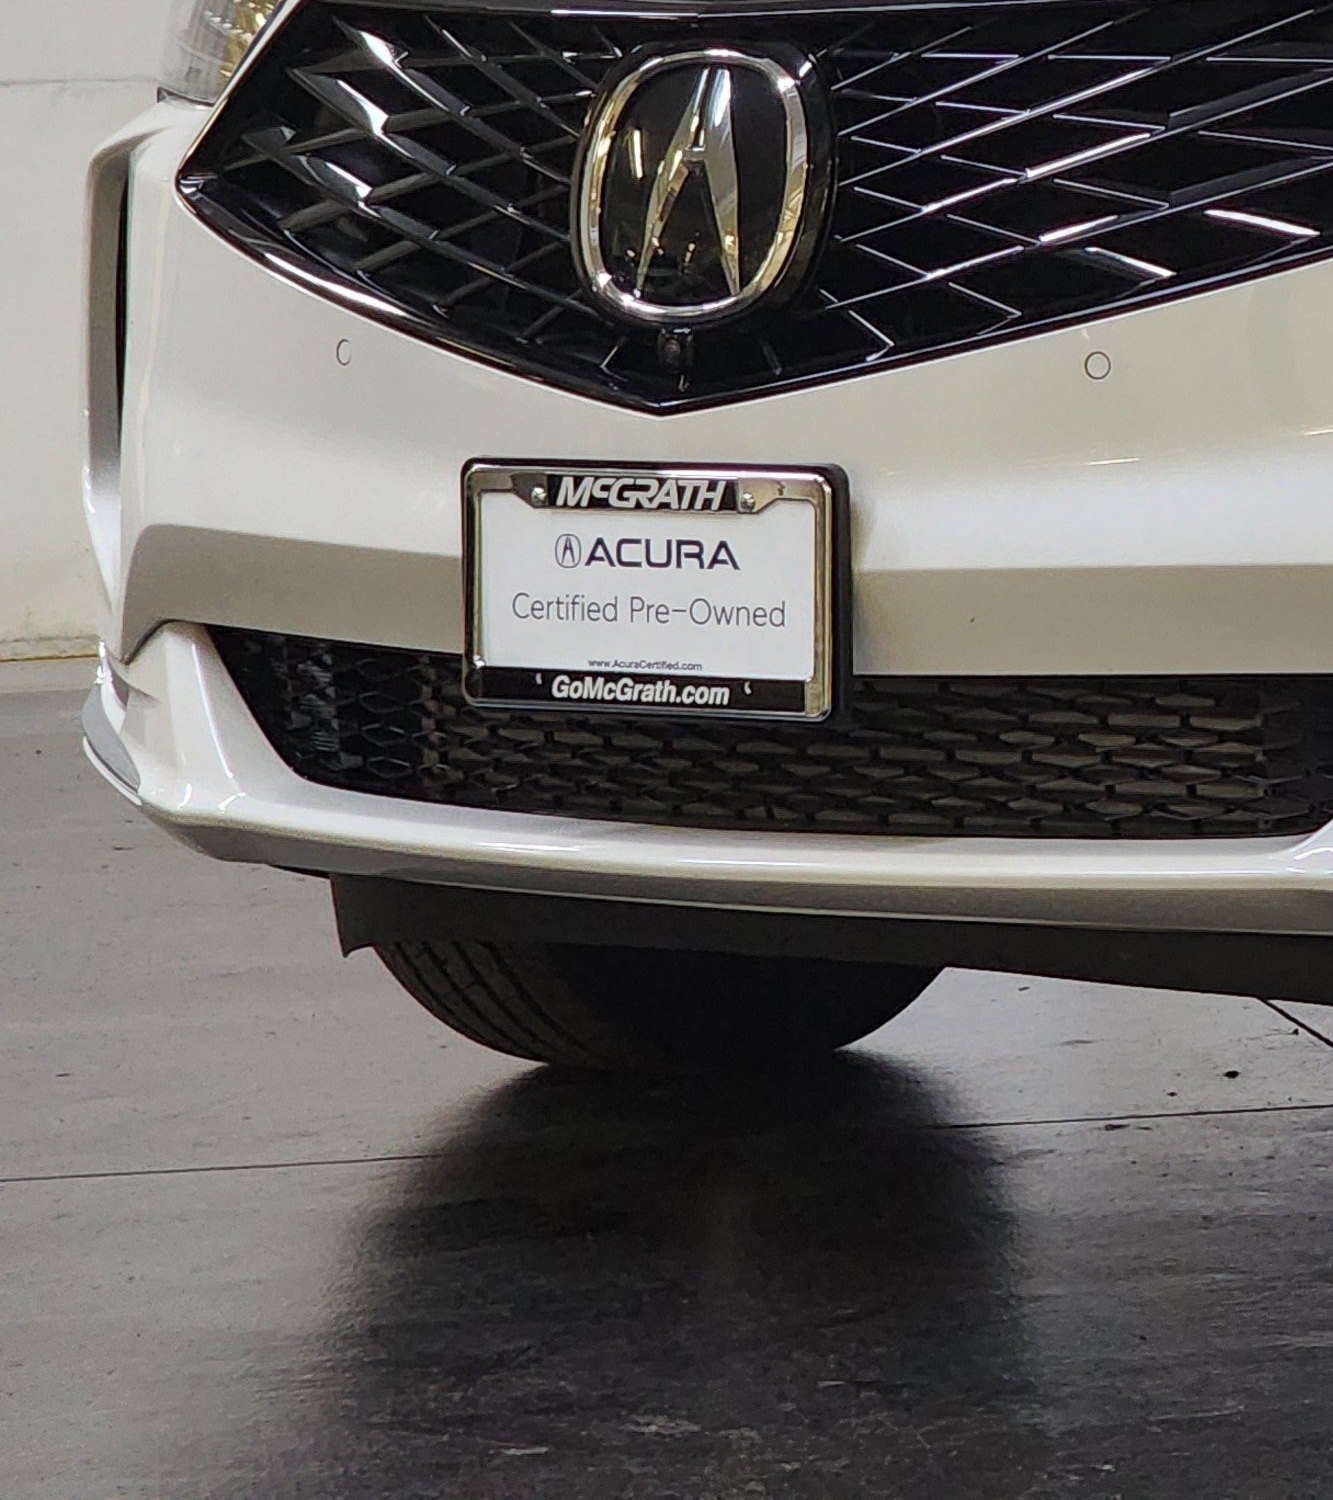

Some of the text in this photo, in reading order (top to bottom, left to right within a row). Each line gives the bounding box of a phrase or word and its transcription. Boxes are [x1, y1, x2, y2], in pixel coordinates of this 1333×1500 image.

[584, 537, 741, 570] ACURA
[511, 592, 786, 628] Certified Pre-Owned
[588, 659, 703, 671] www.AcuraCertified.com
[552, 674, 730, 706] GoMcGrath.com
